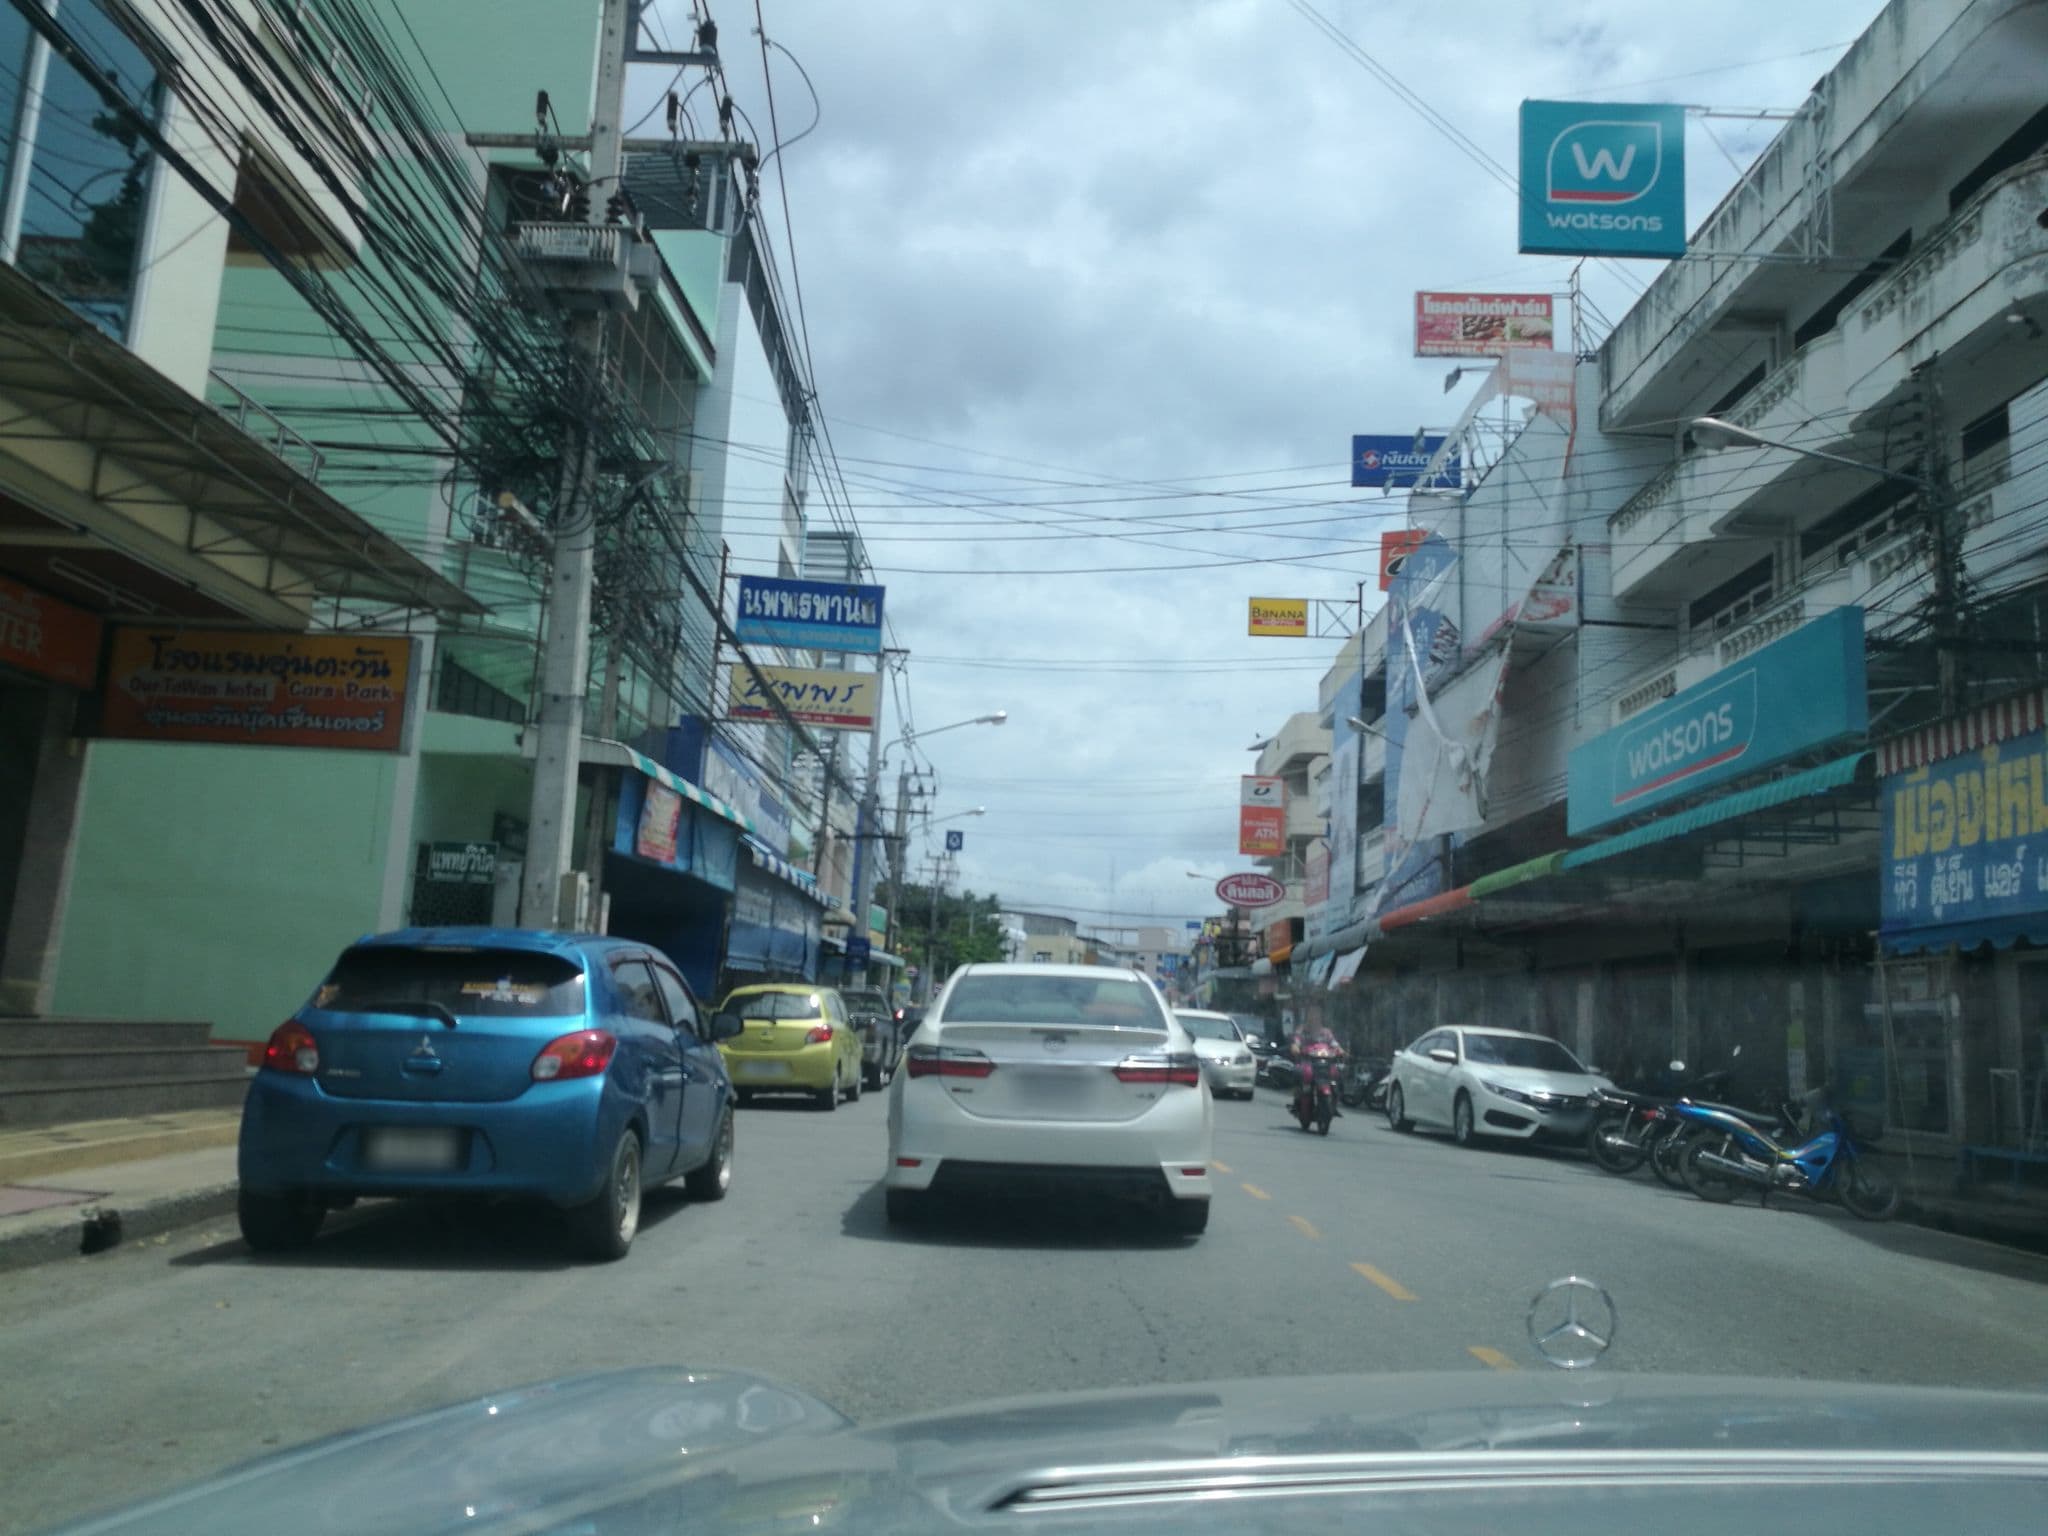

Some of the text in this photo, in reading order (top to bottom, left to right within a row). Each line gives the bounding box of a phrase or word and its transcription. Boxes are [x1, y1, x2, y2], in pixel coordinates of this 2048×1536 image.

[1547, 212, 1663, 231] watsons
[345, 682, 392, 700] Park
[1628, 703, 1733, 780] watsons
